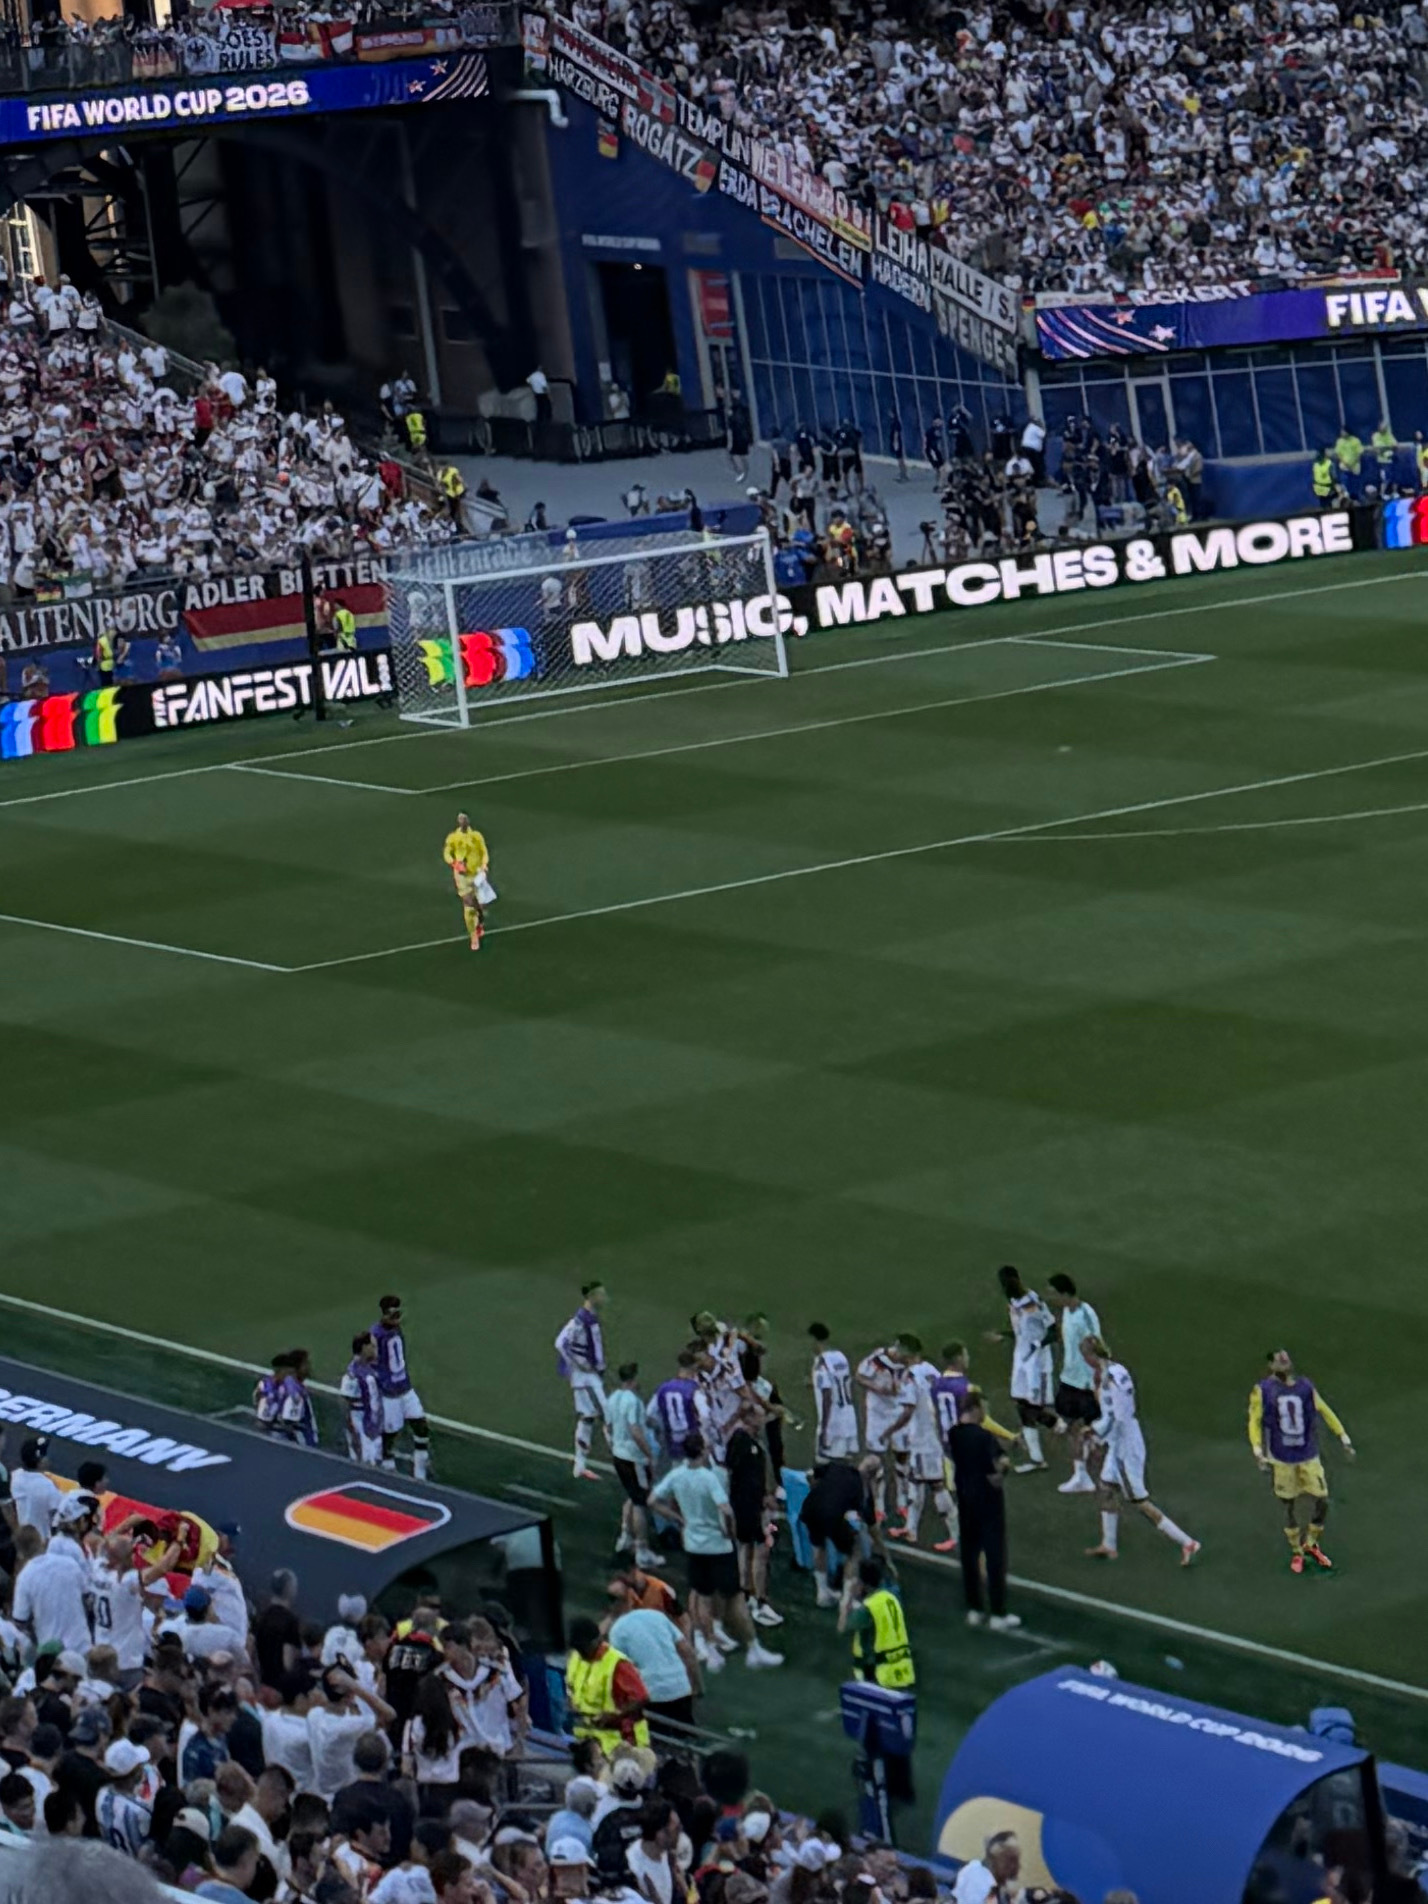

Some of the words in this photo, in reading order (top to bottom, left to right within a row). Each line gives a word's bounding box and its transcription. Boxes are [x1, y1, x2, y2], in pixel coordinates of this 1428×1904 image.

[218, 50, 275, 71] RULES
[27, 103, 81, 132] FIFA
[81, 94, 172, 126] WORLD
[174, 89, 223, 116] CUP
[225, 81, 309, 112] 2026
[931, 255, 983, 309] HALLE
[1326, 290, 1416, 327] FIFA
[184, 574, 266, 611] ADLER
[569, 595, 809, 667] MUSIC,
[816, 543, 1120, 629] MATCHES
[1124, 539, 1166, 583] &
[1172, 511, 1353, 575] MORE
[166, 655, 381, 726] FANFESTVAL
